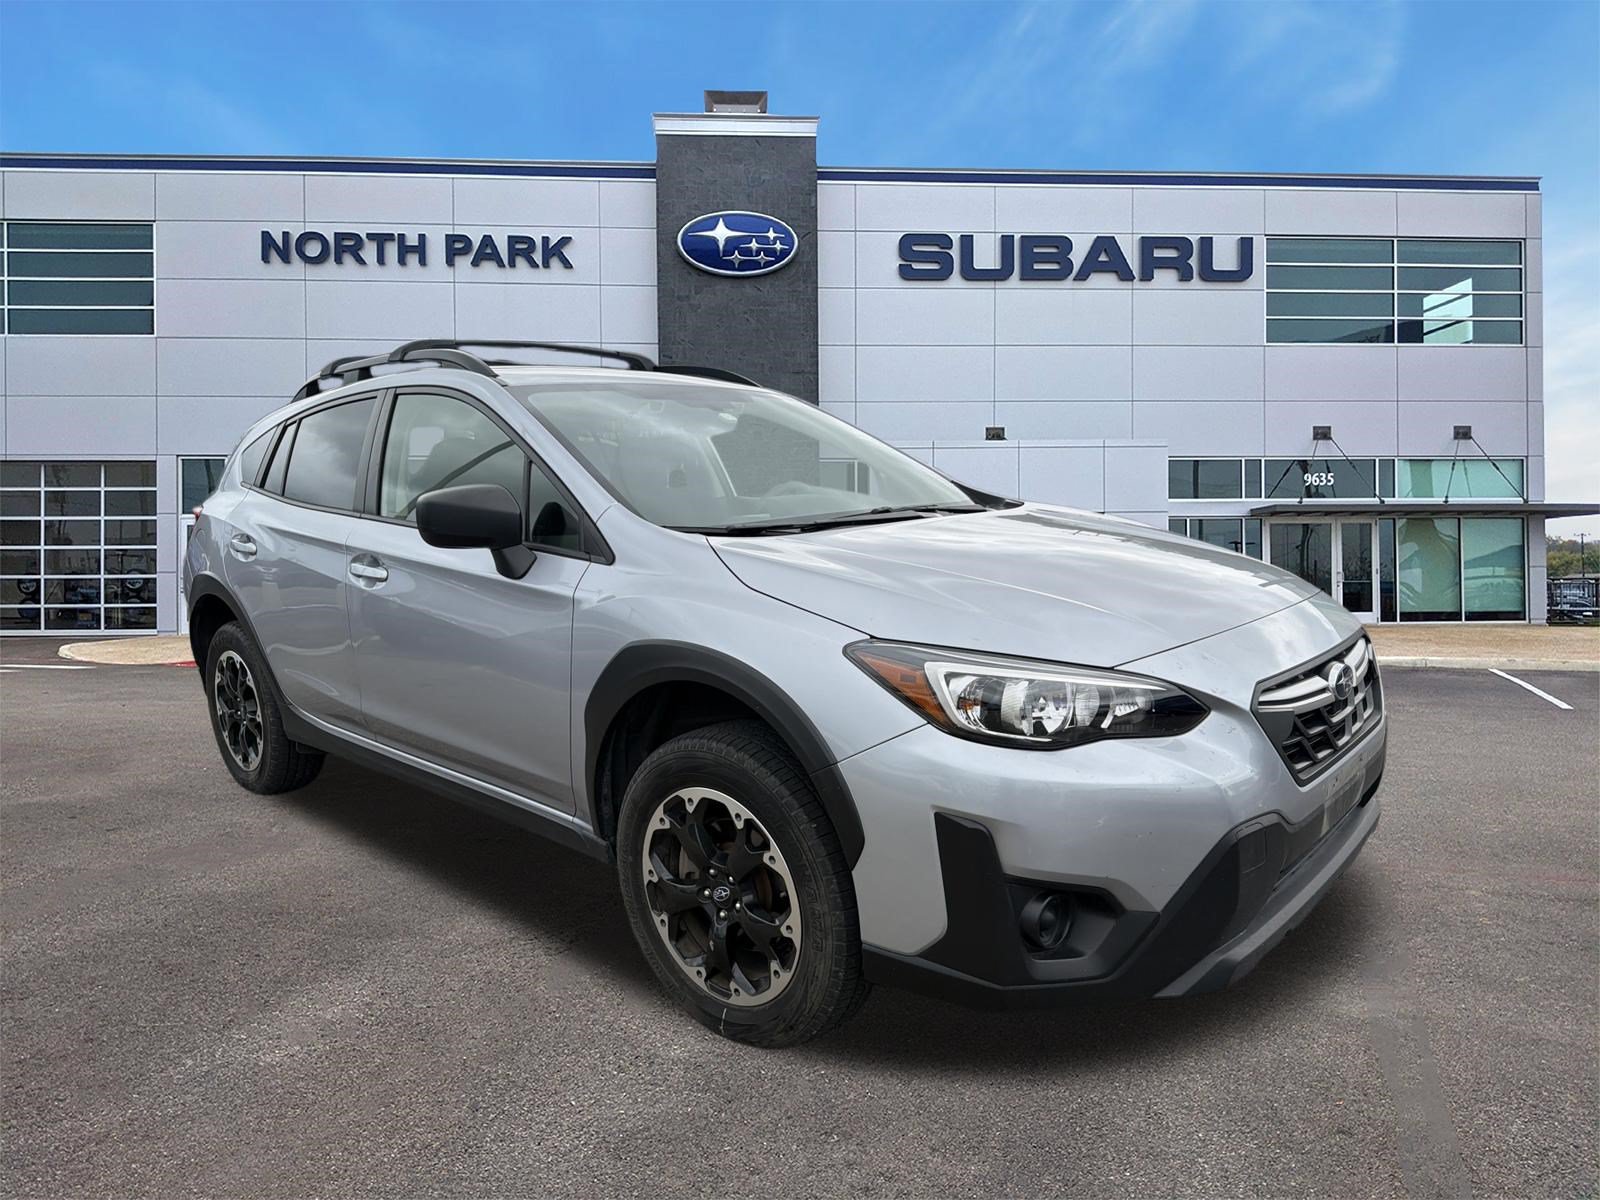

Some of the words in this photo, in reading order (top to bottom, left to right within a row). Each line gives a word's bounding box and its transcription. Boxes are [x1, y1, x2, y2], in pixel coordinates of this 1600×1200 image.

[261, 230, 427, 267] NORTH
[445, 233, 574, 270] PARK
[898, 233, 1254, 284] SUBARU
[1303, 472, 1335, 487] 9635
